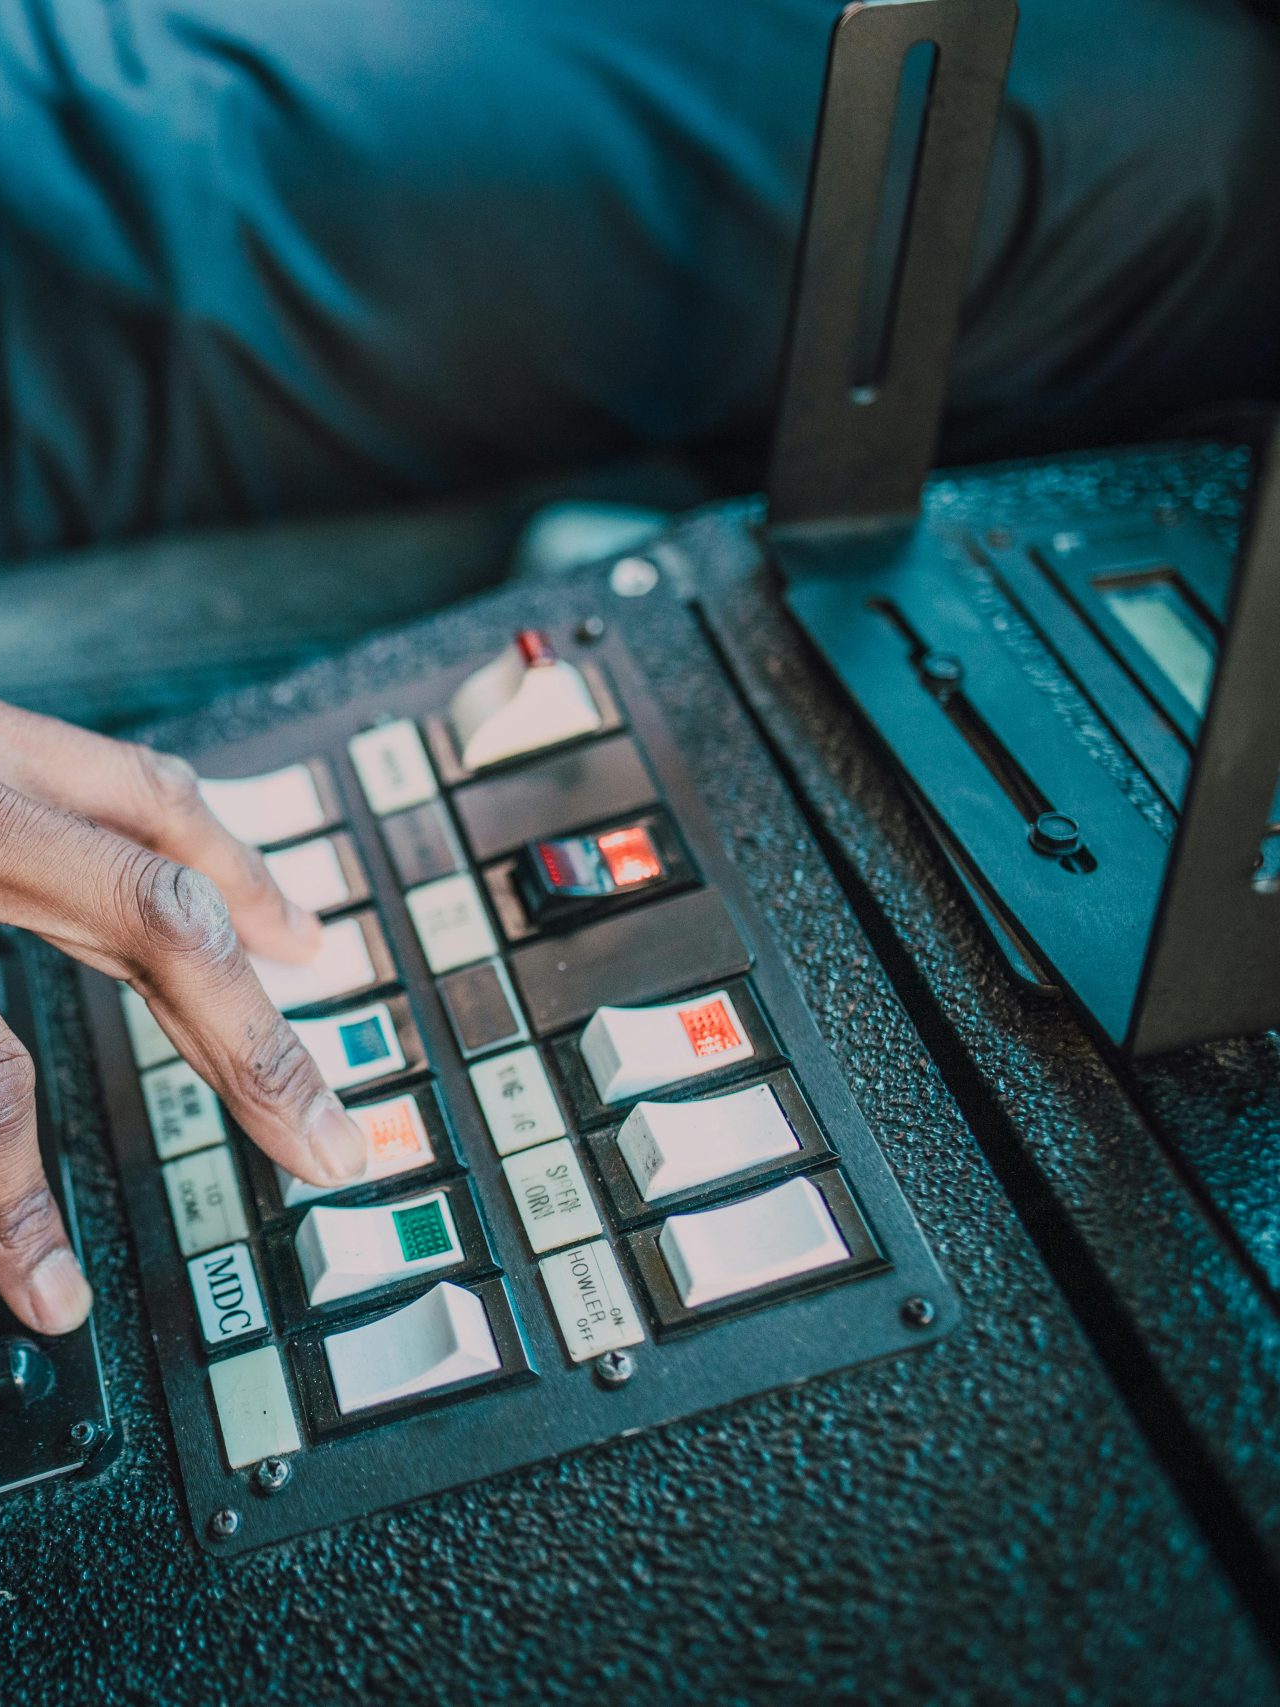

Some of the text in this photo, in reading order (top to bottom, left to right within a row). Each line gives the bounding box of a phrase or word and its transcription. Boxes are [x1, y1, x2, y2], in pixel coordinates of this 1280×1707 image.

[204, 1255, 253, 1335] MDC
[568, 1250, 607, 1326] HOWLER
[576, 1317, 595, 1343] OFF
[610, 1307, 626, 1327] ON
